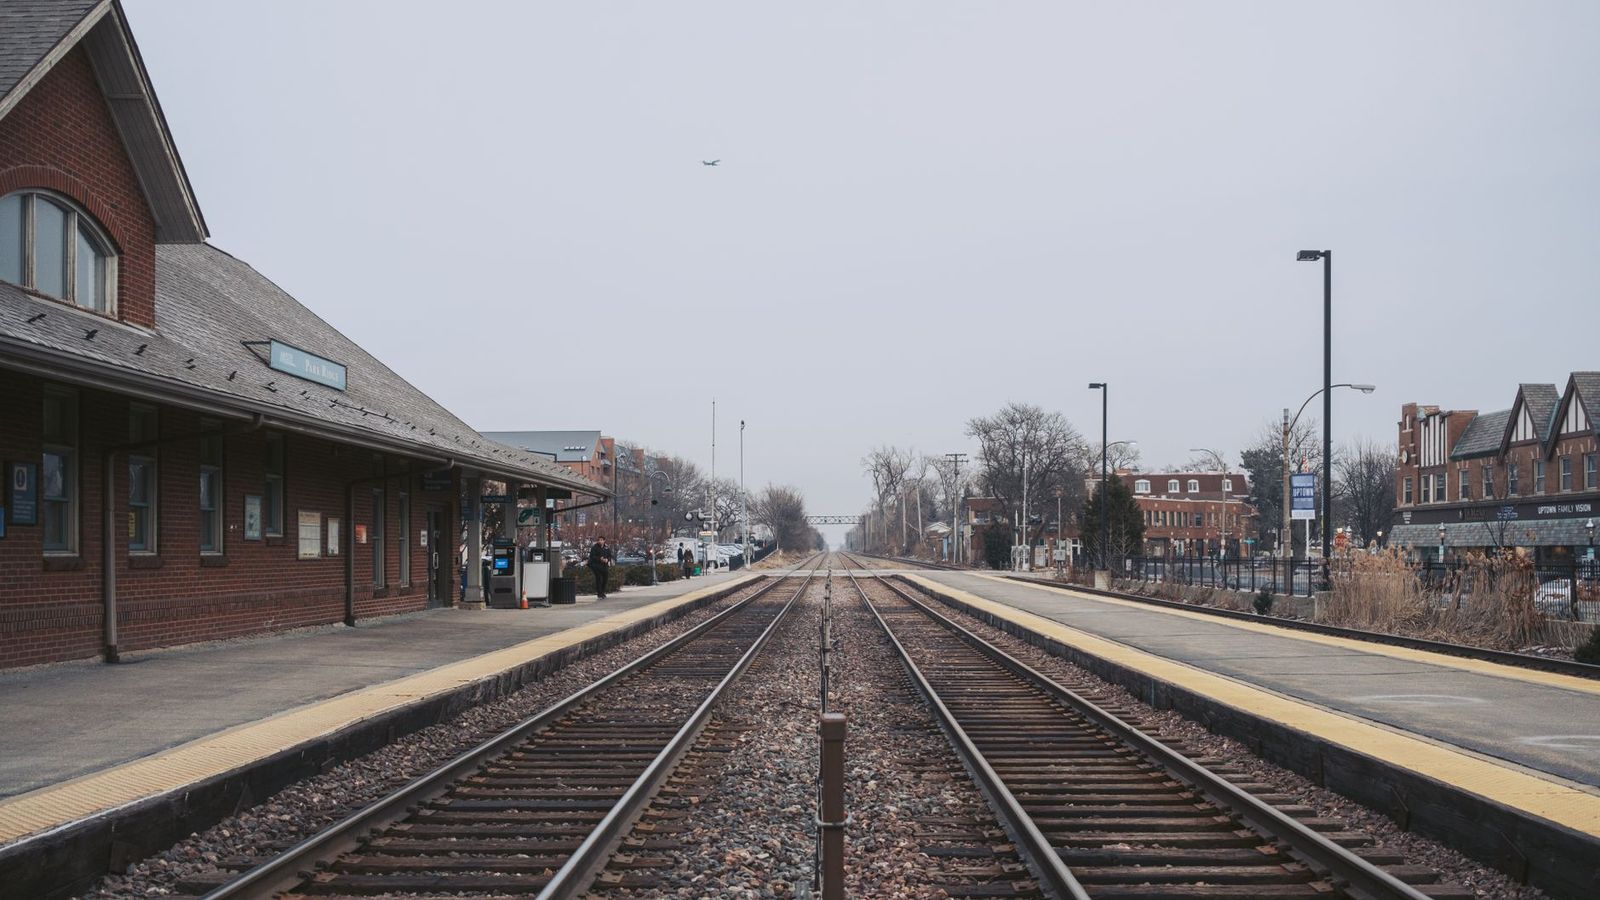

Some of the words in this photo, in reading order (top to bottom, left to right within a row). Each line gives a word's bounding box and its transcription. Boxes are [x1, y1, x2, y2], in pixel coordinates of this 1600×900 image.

[1292, 487, 1314, 497] UPTOWN
[1537, 505, 1557, 514] UPTOWN
[1557, 504, 1574, 513] FAMILY
[1574, 503, 1592, 512] VISION
